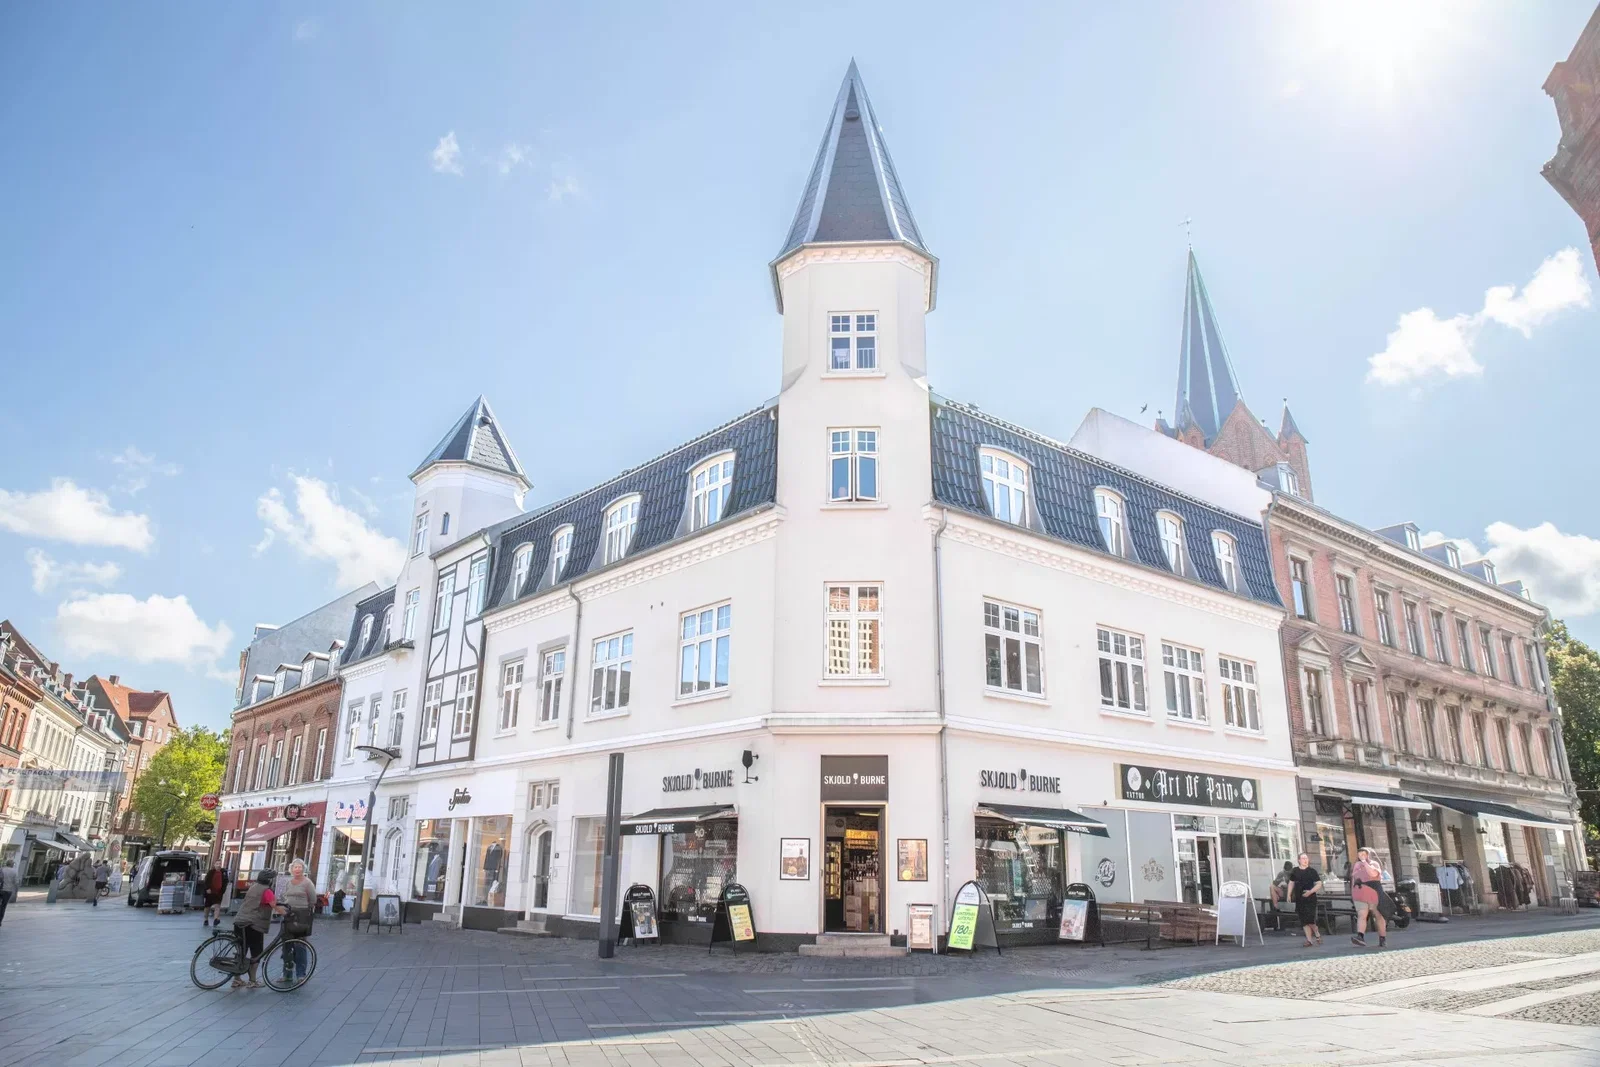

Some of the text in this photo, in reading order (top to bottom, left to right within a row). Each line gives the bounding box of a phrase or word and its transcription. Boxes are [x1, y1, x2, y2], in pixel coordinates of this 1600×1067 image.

[662, 770, 734, 793] SKJOLD BURNE
[823, 775, 886, 785] SKJOLD BURNE
[980, 769, 1062, 794] SKJOLD BURNE
[1152, 769, 1180, 802] Art
[1206, 775, 1234, 806] Pain
[635, 823, 675, 834] SKJOLD BURNE
[953, 924, 969, 935] 180
